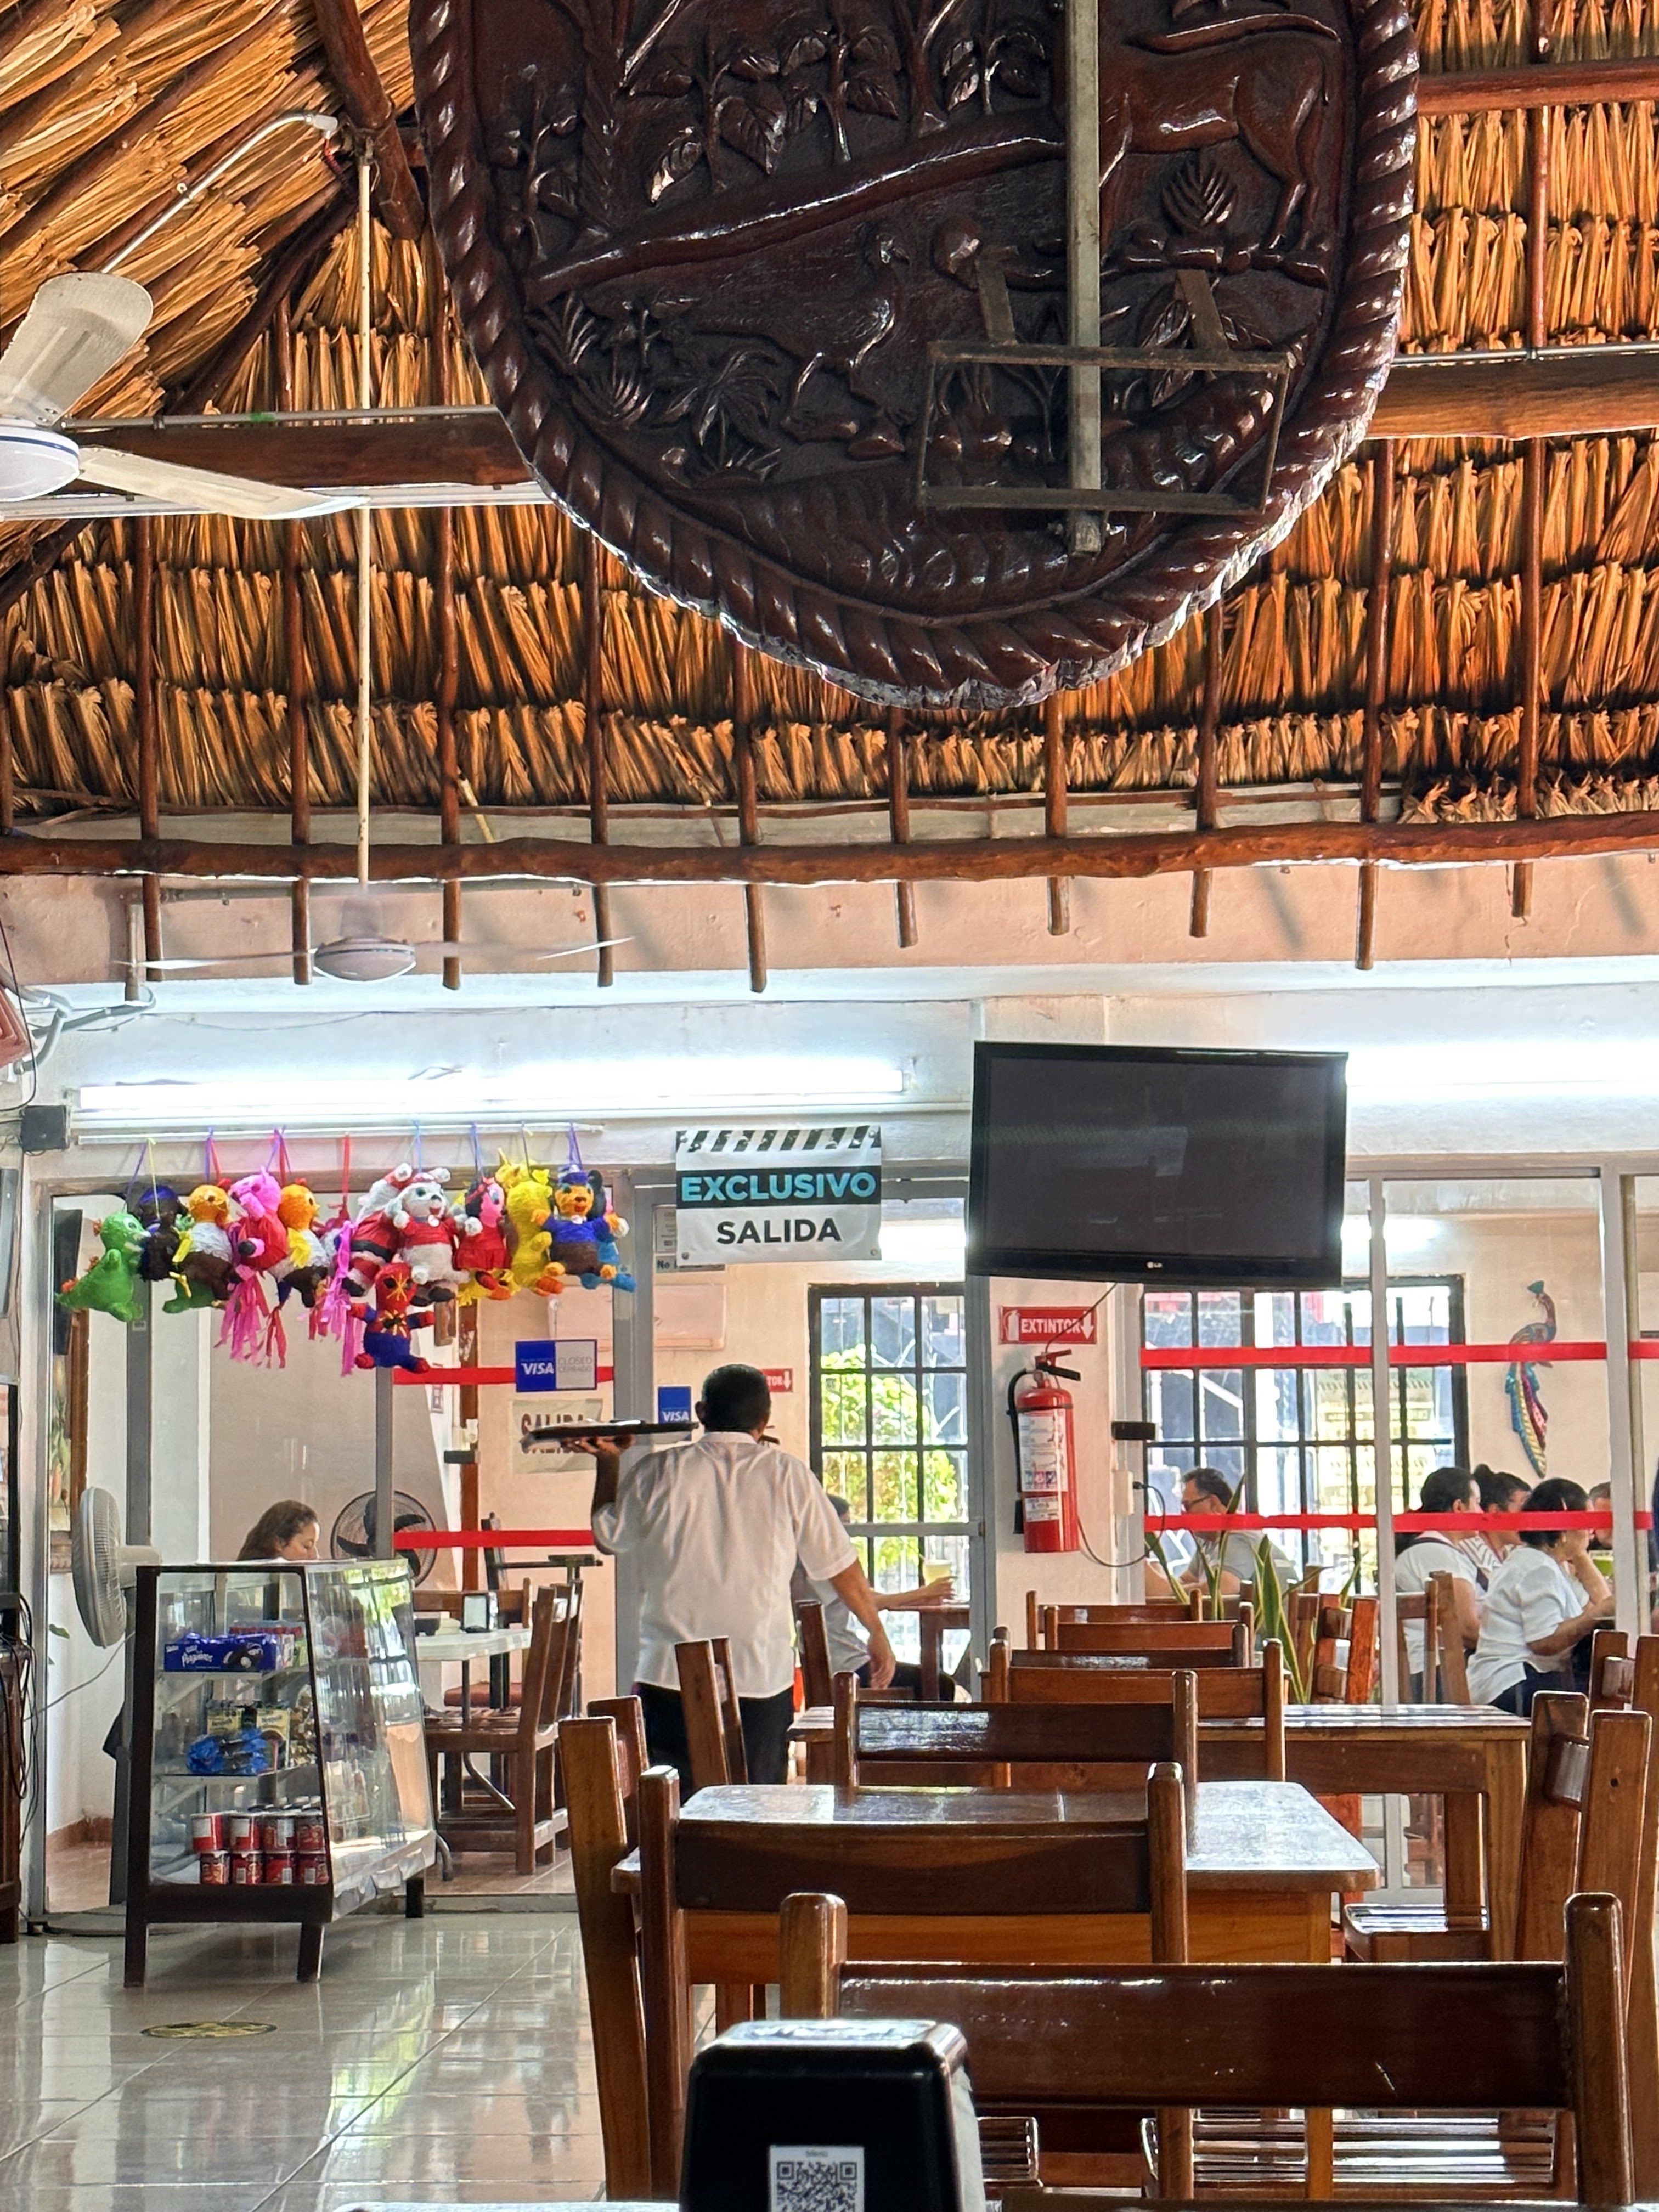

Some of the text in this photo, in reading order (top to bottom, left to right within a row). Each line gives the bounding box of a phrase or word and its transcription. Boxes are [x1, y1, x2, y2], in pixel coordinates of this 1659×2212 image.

[682, 1173, 875, 1201] EXCLUSIVO
[716, 1218, 842, 1244] SALIDA
[1020, 1318, 1081, 1334] EXTINTOR
[521, 1362, 554, 1375] VISA
[662, 1410, 690, 1422] VISA
